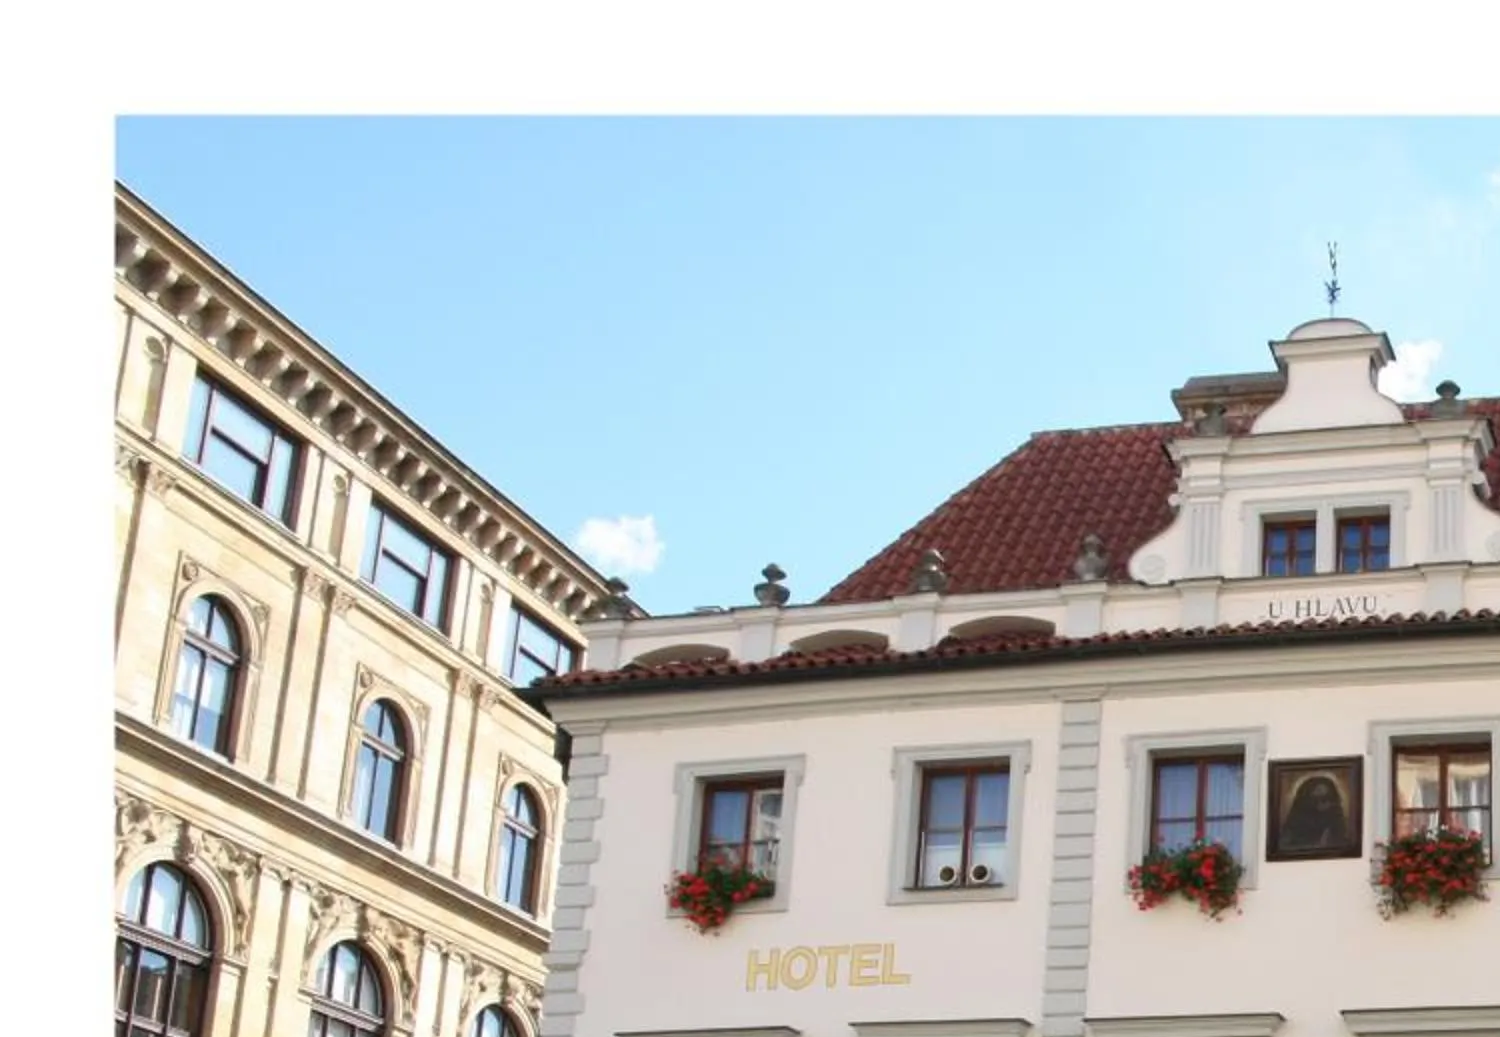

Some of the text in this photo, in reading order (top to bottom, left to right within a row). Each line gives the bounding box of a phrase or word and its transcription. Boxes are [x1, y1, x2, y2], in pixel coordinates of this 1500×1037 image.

[1268, 595, 1378, 619] U HLAVU
[745, 942, 912, 992] HOTEL
